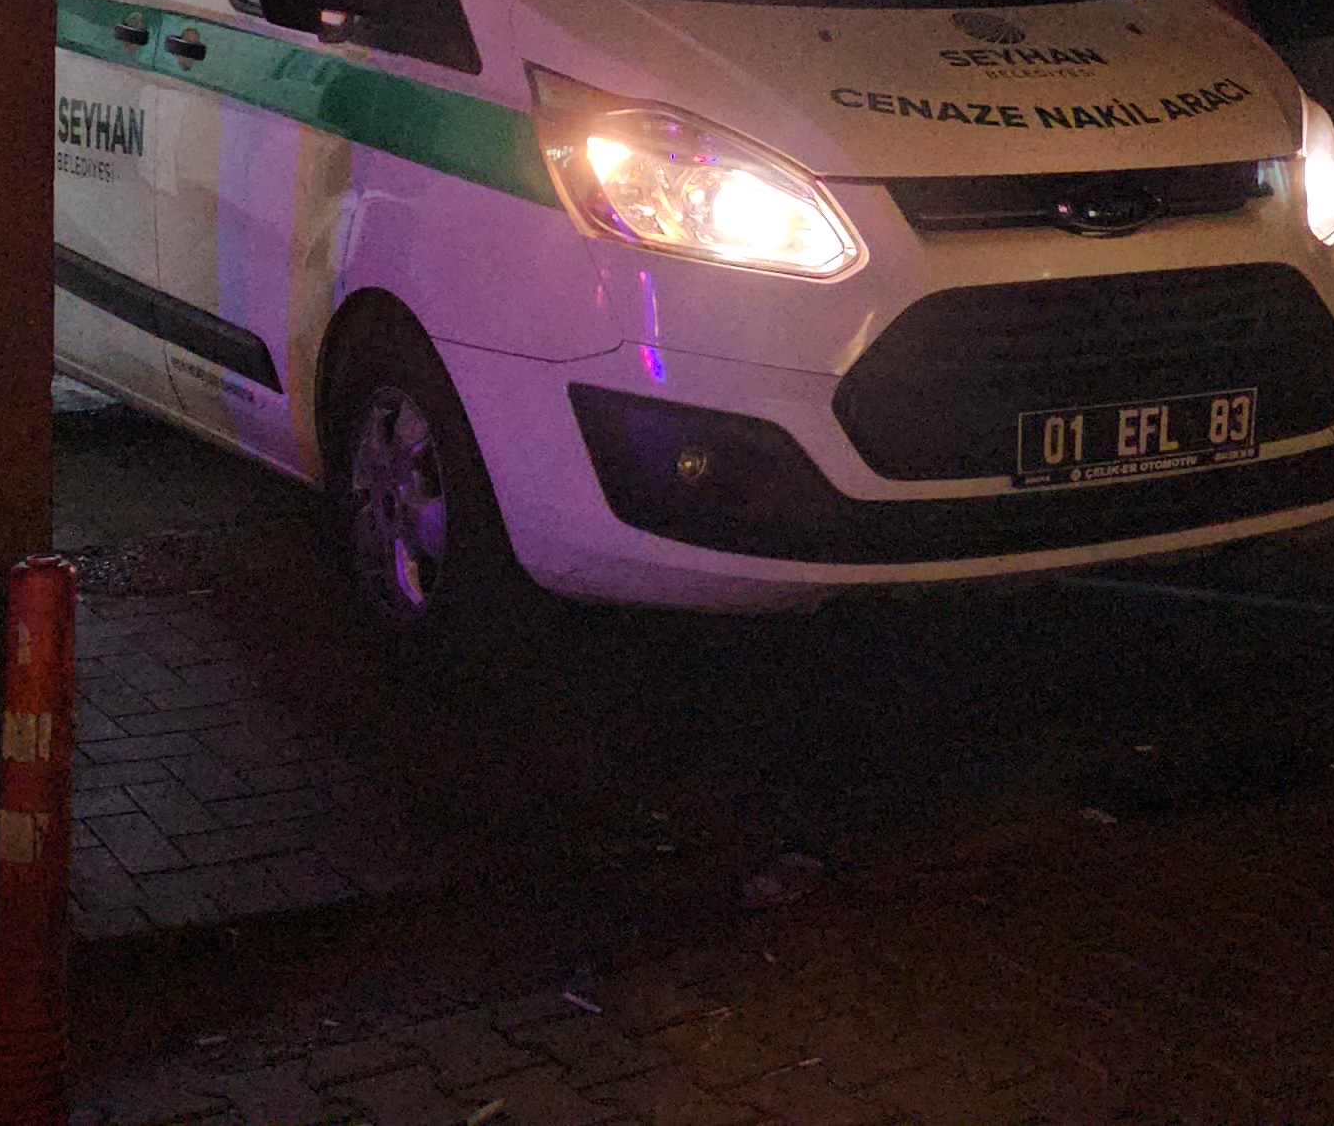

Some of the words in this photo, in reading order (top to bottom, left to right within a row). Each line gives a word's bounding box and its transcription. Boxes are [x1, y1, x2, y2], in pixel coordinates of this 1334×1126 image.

[939, 47, 1109, 68] SEYHAN
[57, 96, 146, 157] SEYHAN
[829, 86, 1030, 129] CENAZE
[1034, 96, 1162, 130] NAKİL
[1160, 77, 1253, 121] ARACI
[1043, 415, 1084, 465] 01
[1118, 405, 1179, 456] EFL
[1209, 395, 1250, 444] 83
